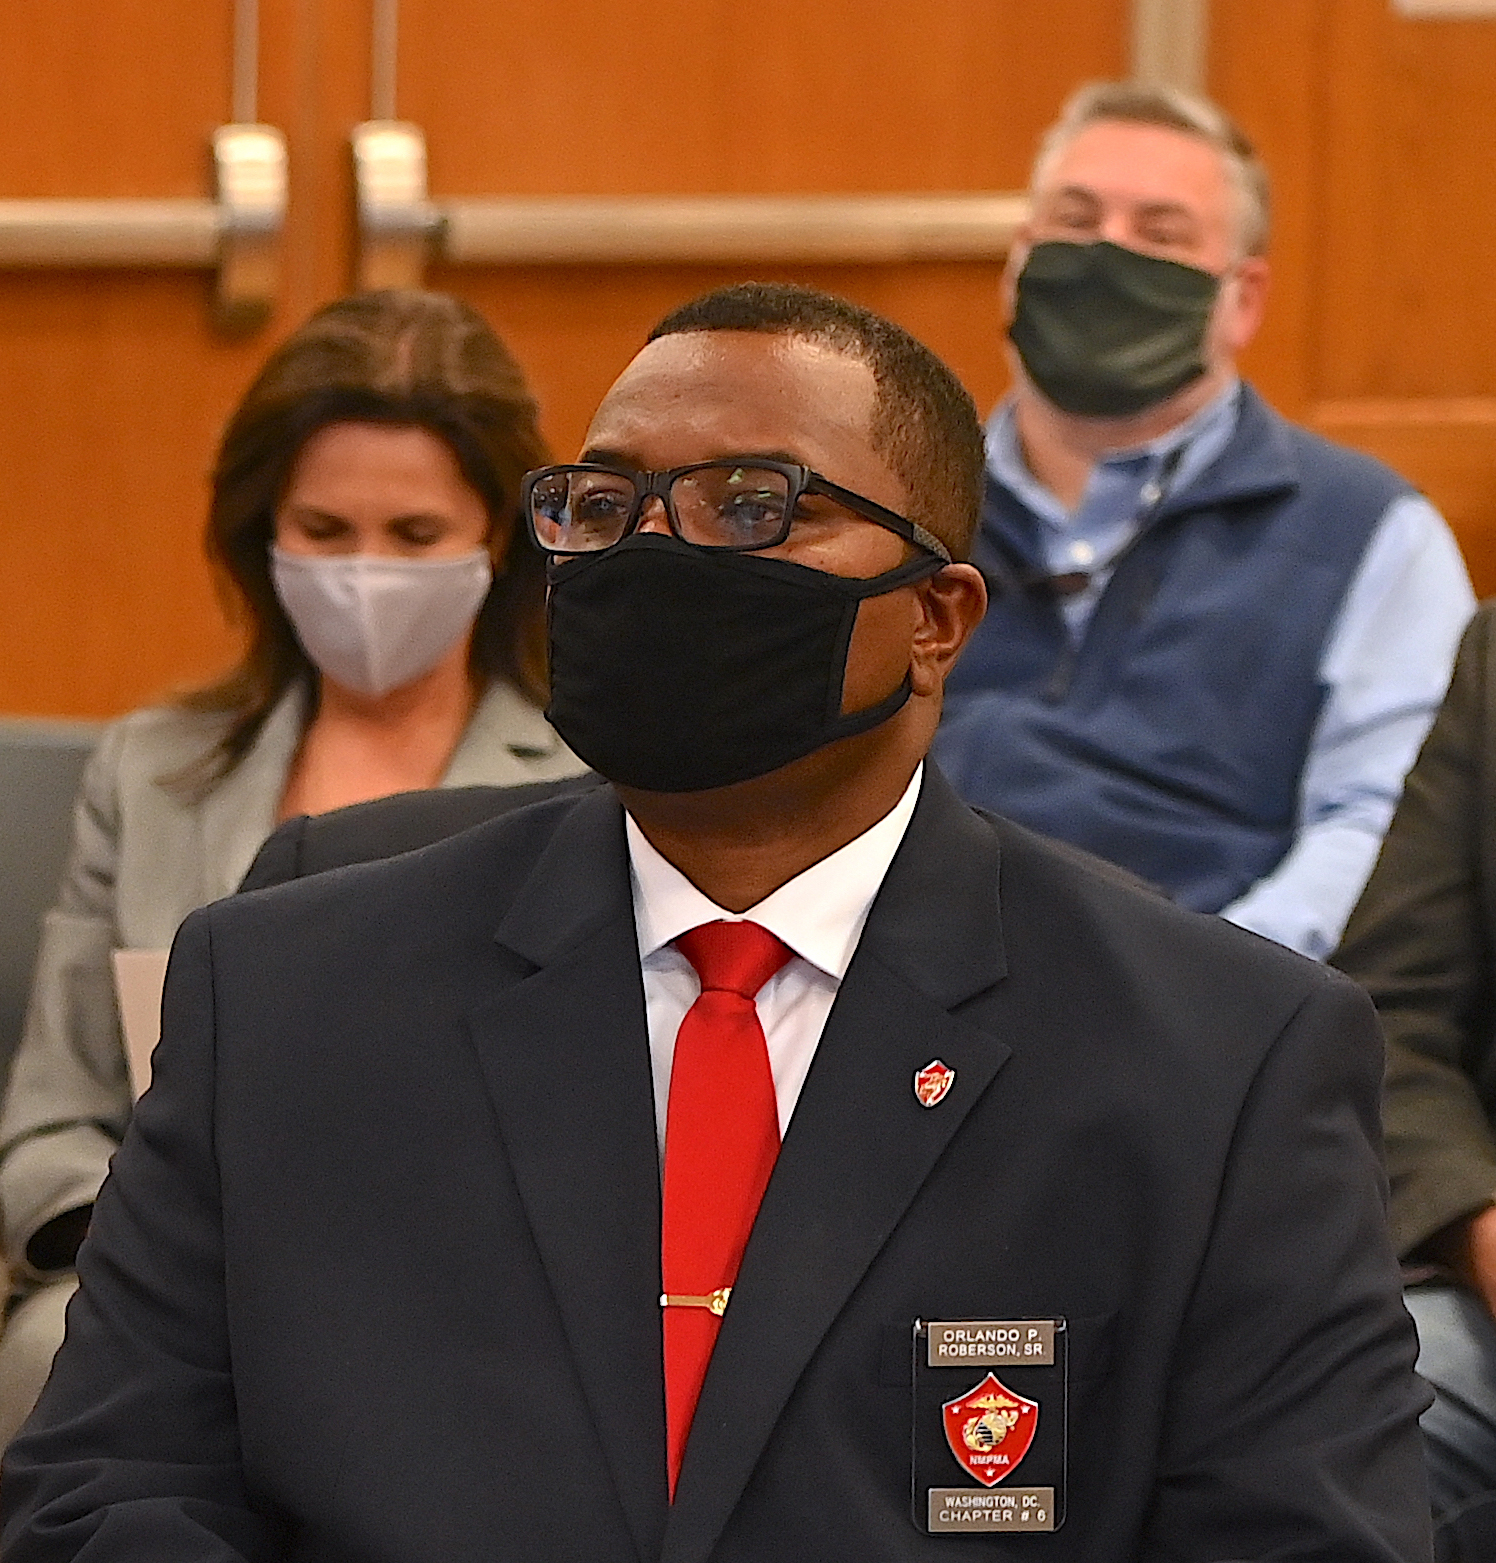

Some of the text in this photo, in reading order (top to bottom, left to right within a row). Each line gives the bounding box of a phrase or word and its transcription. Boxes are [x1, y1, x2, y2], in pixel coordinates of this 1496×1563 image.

[943, 1328, 1042, 1342] ORLANDO P.
[938, 1343, 1020, 1357] ROBERSON,
[969, 1455, 1010, 1465] NMPMA
[945, 1496, 1018, 1508] WASHINGTON,
[939, 1510, 1013, 1522] CHAPTER
[1037, 1509, 1046, 1522] 6
